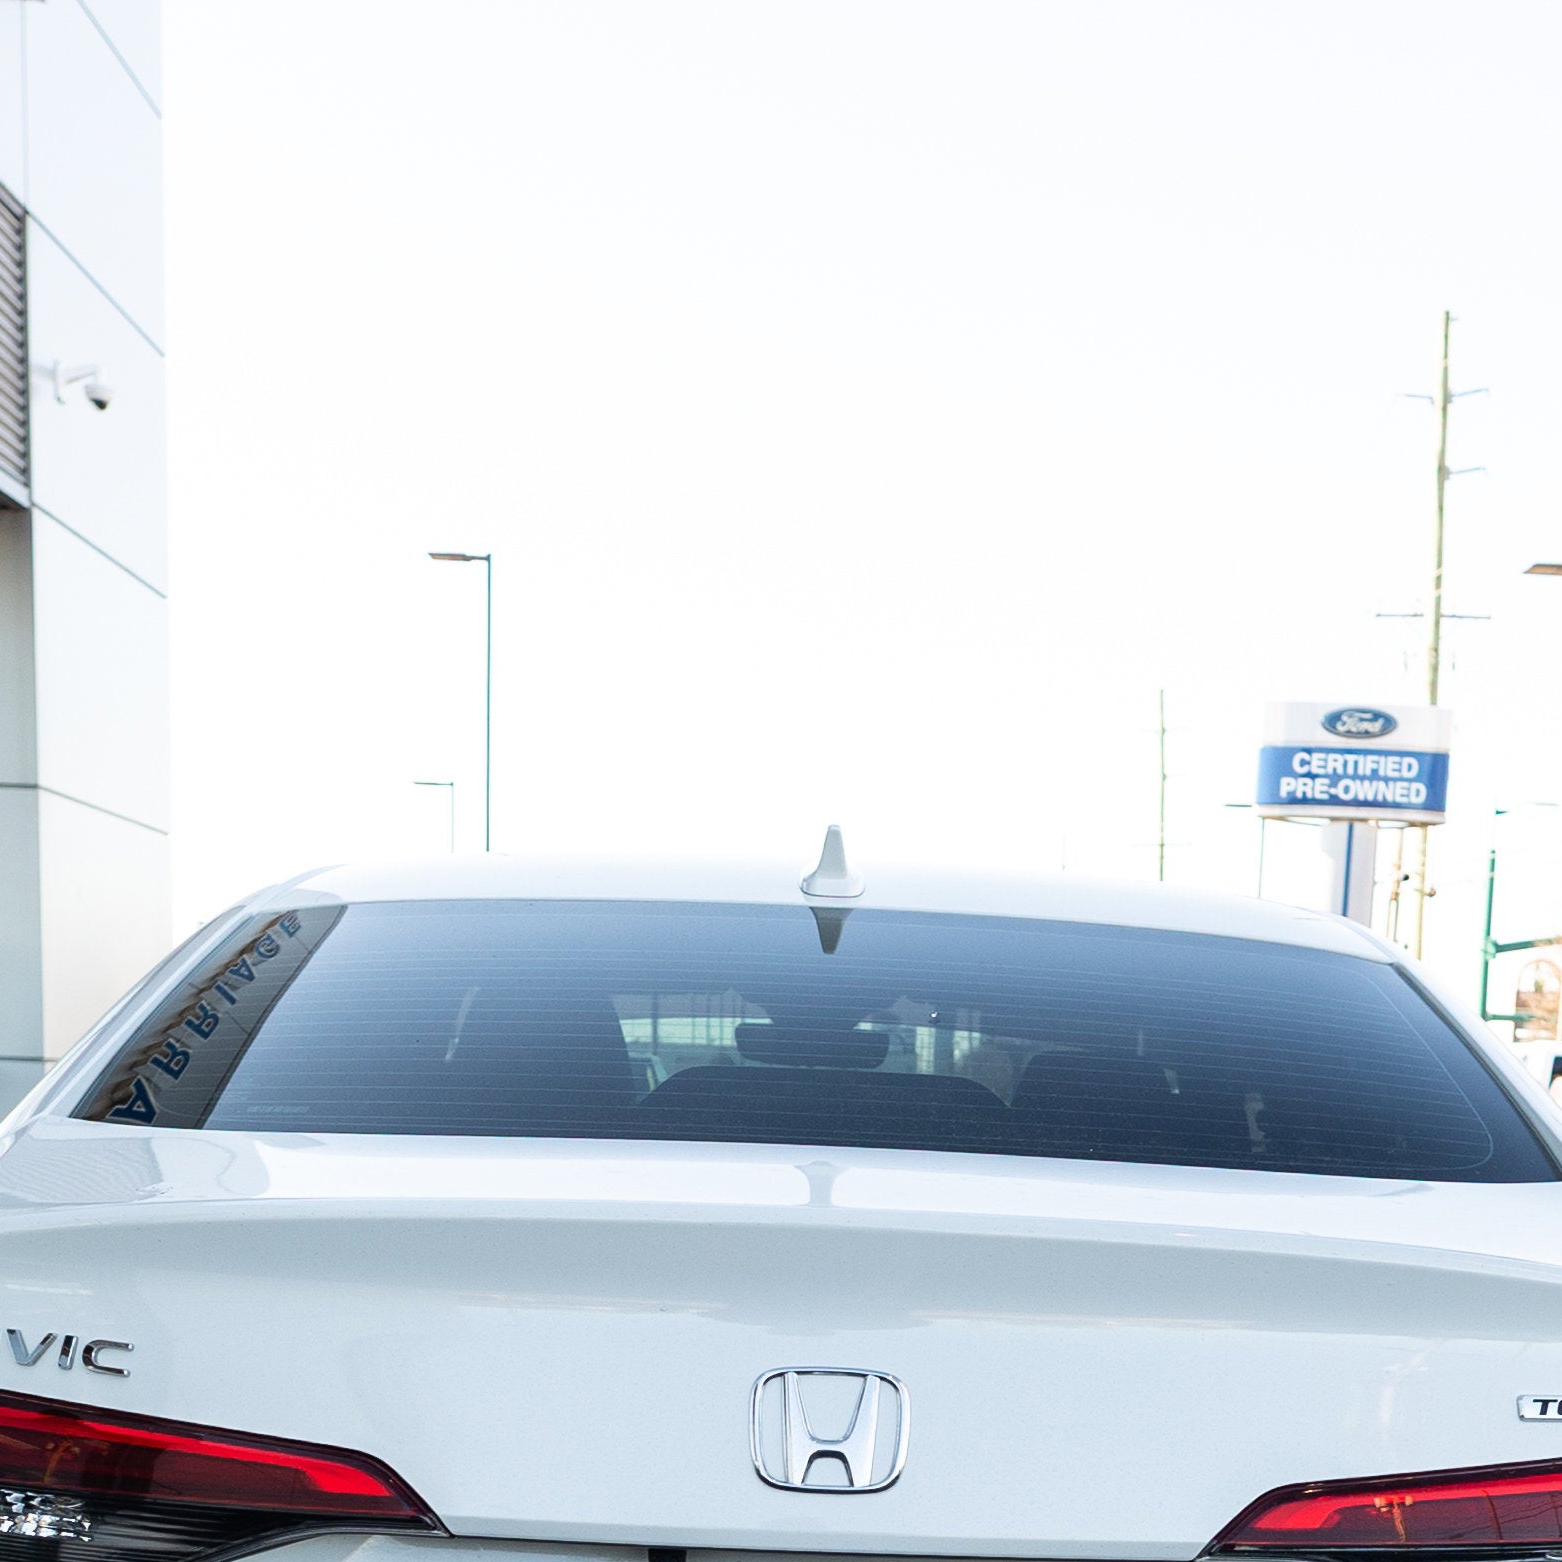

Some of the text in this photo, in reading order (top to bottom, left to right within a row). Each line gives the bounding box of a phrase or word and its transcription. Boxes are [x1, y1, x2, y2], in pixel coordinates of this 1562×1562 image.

[1336, 710, 1385, 733] Ford
[1292, 752, 1419, 778] CERTIFIED
[1279, 777, 1427, 804] PRE-OWNED
